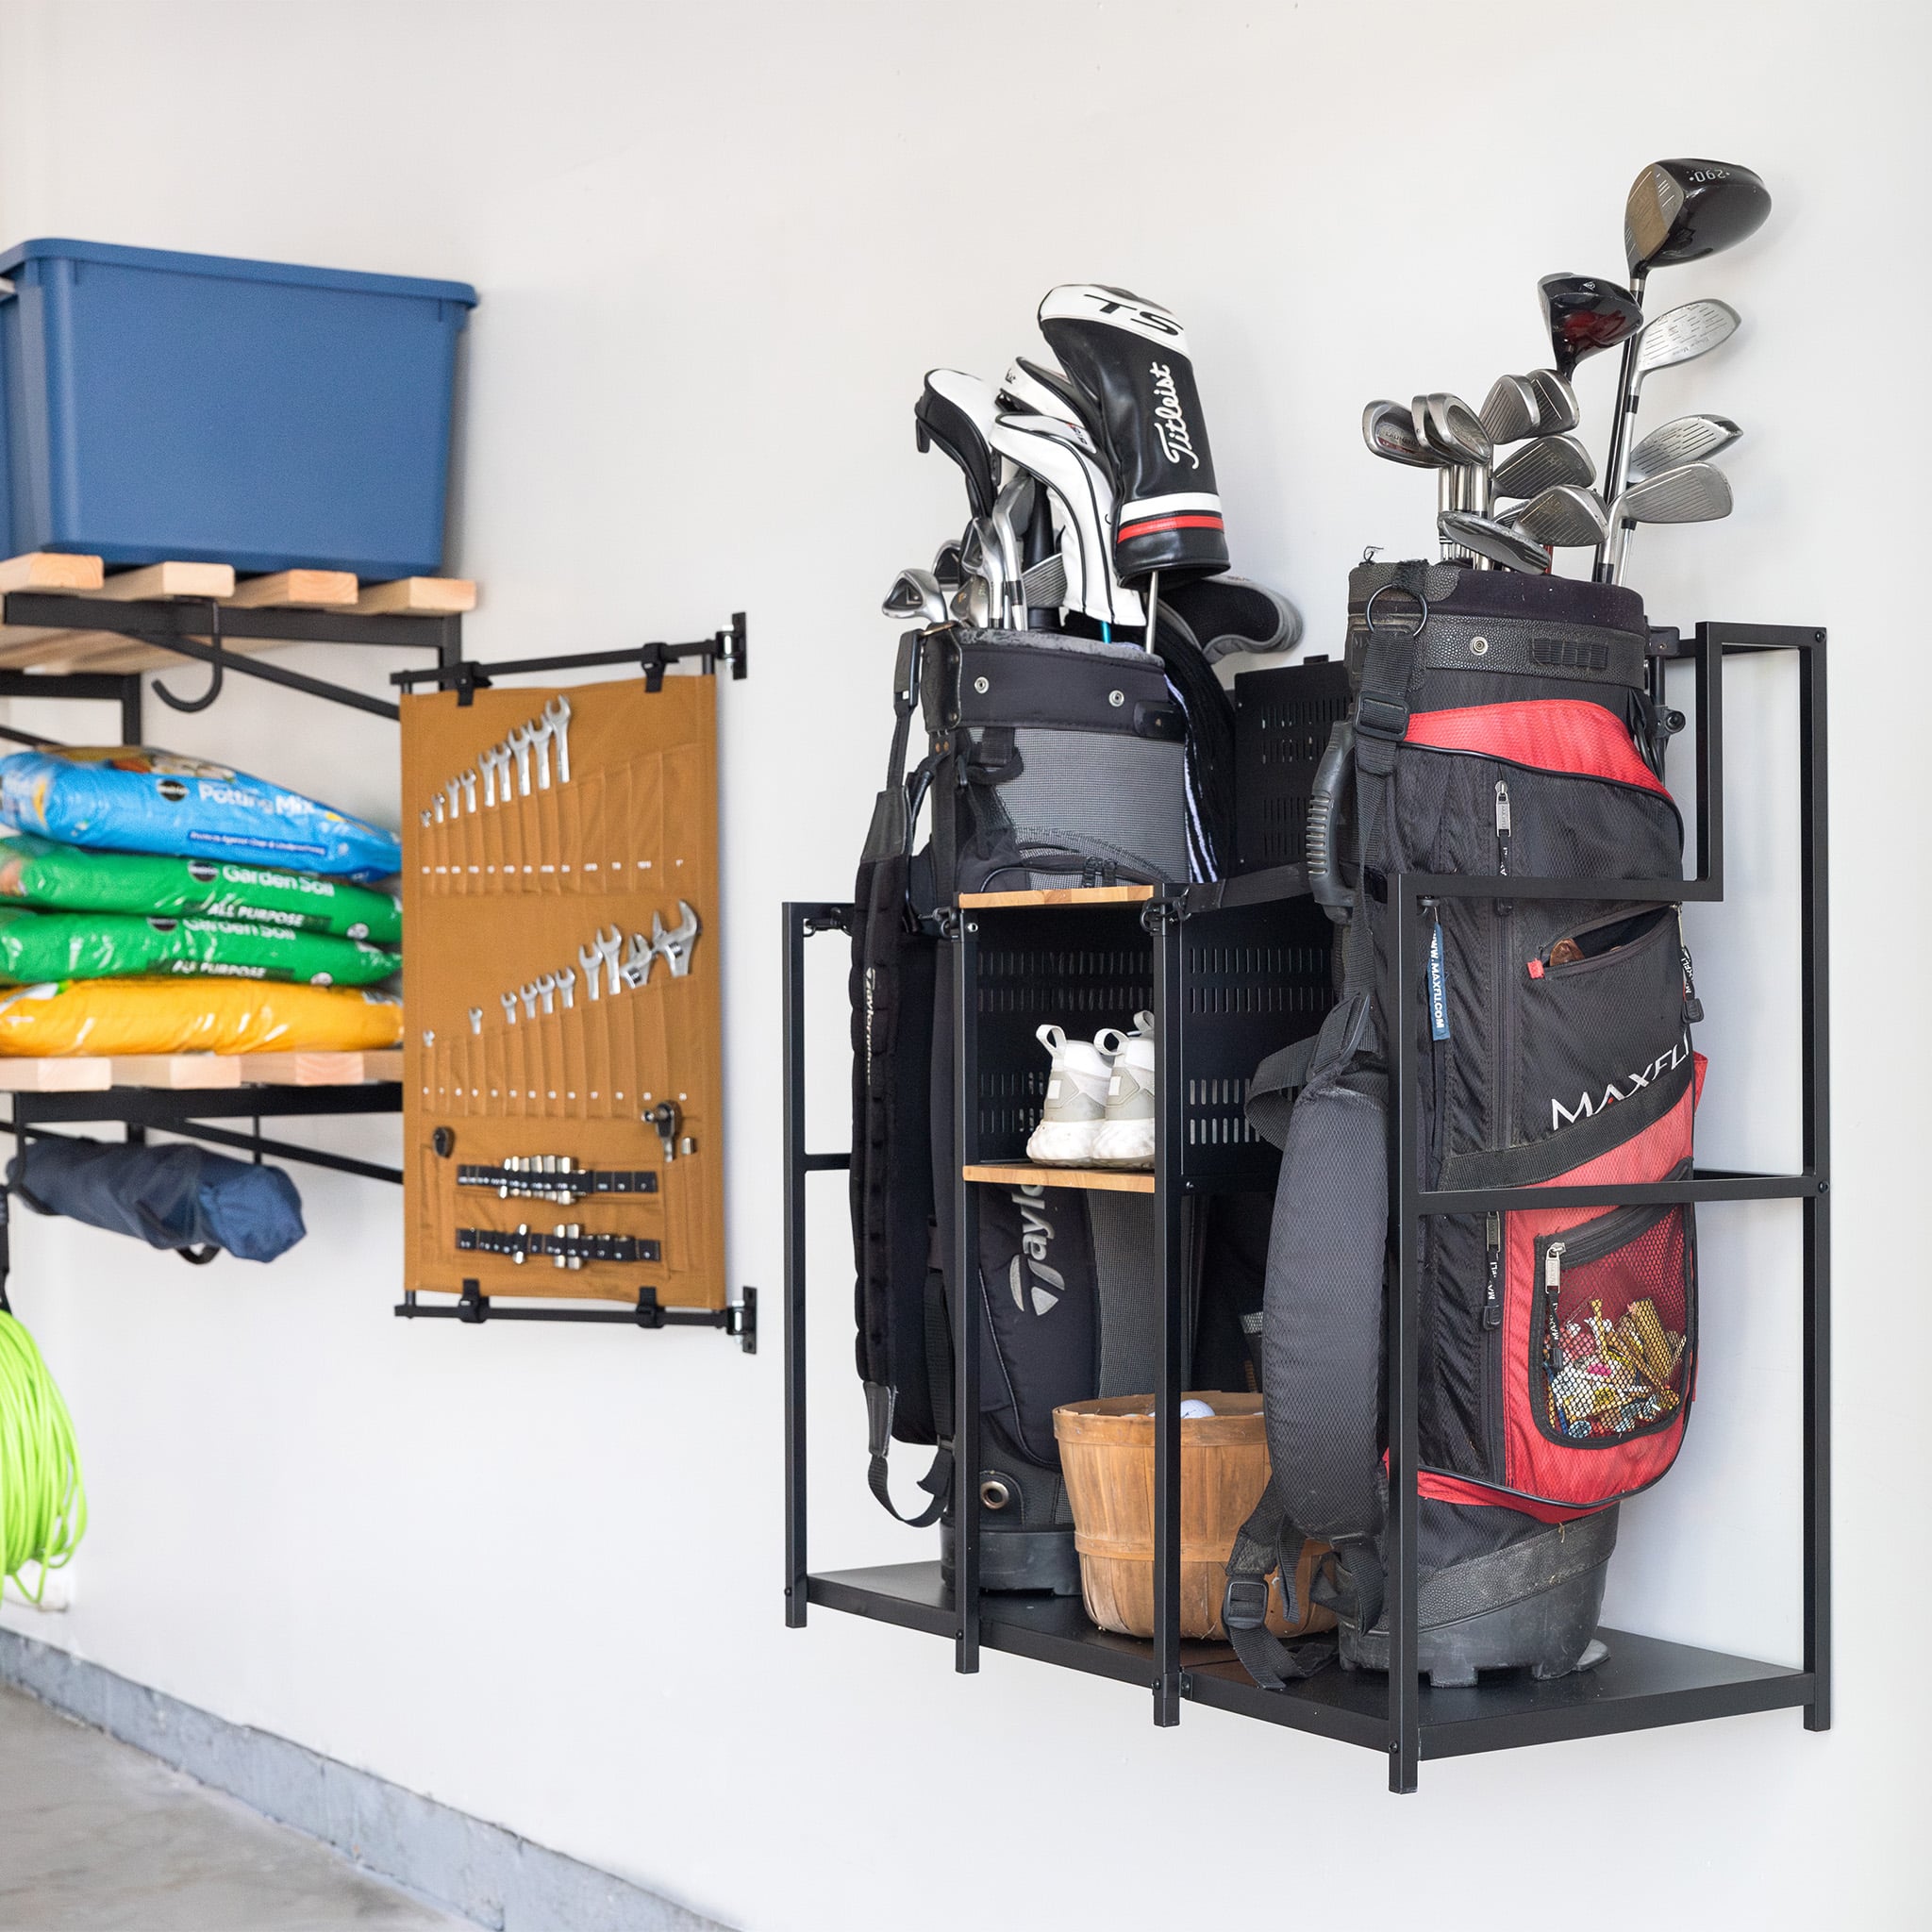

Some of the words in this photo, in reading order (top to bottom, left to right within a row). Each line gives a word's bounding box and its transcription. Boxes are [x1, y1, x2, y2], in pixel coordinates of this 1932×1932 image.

[1083, 293, 1185, 336] TS
[1149, 361, 1200, 470] Titleist
[198, 782, 275, 815] Potting
[275, 793, 316, 816] Mix
[223, 864, 298, 891] Garden
[299, 877, 335, 897] Soil
[207, 902, 235, 917] ALL
[238, 906, 305, 927] PURPOSE
[200, 961, 267, 978] PURPOSE
[1431, 930, 1444, 1028] WW.MAXFLI.COM
[1681, 958, 1693, 993] MXFLI
[1551, 1027, 1690, 1131] MAXFLI
[1488, 1261, 1497, 1300] MAFLI
